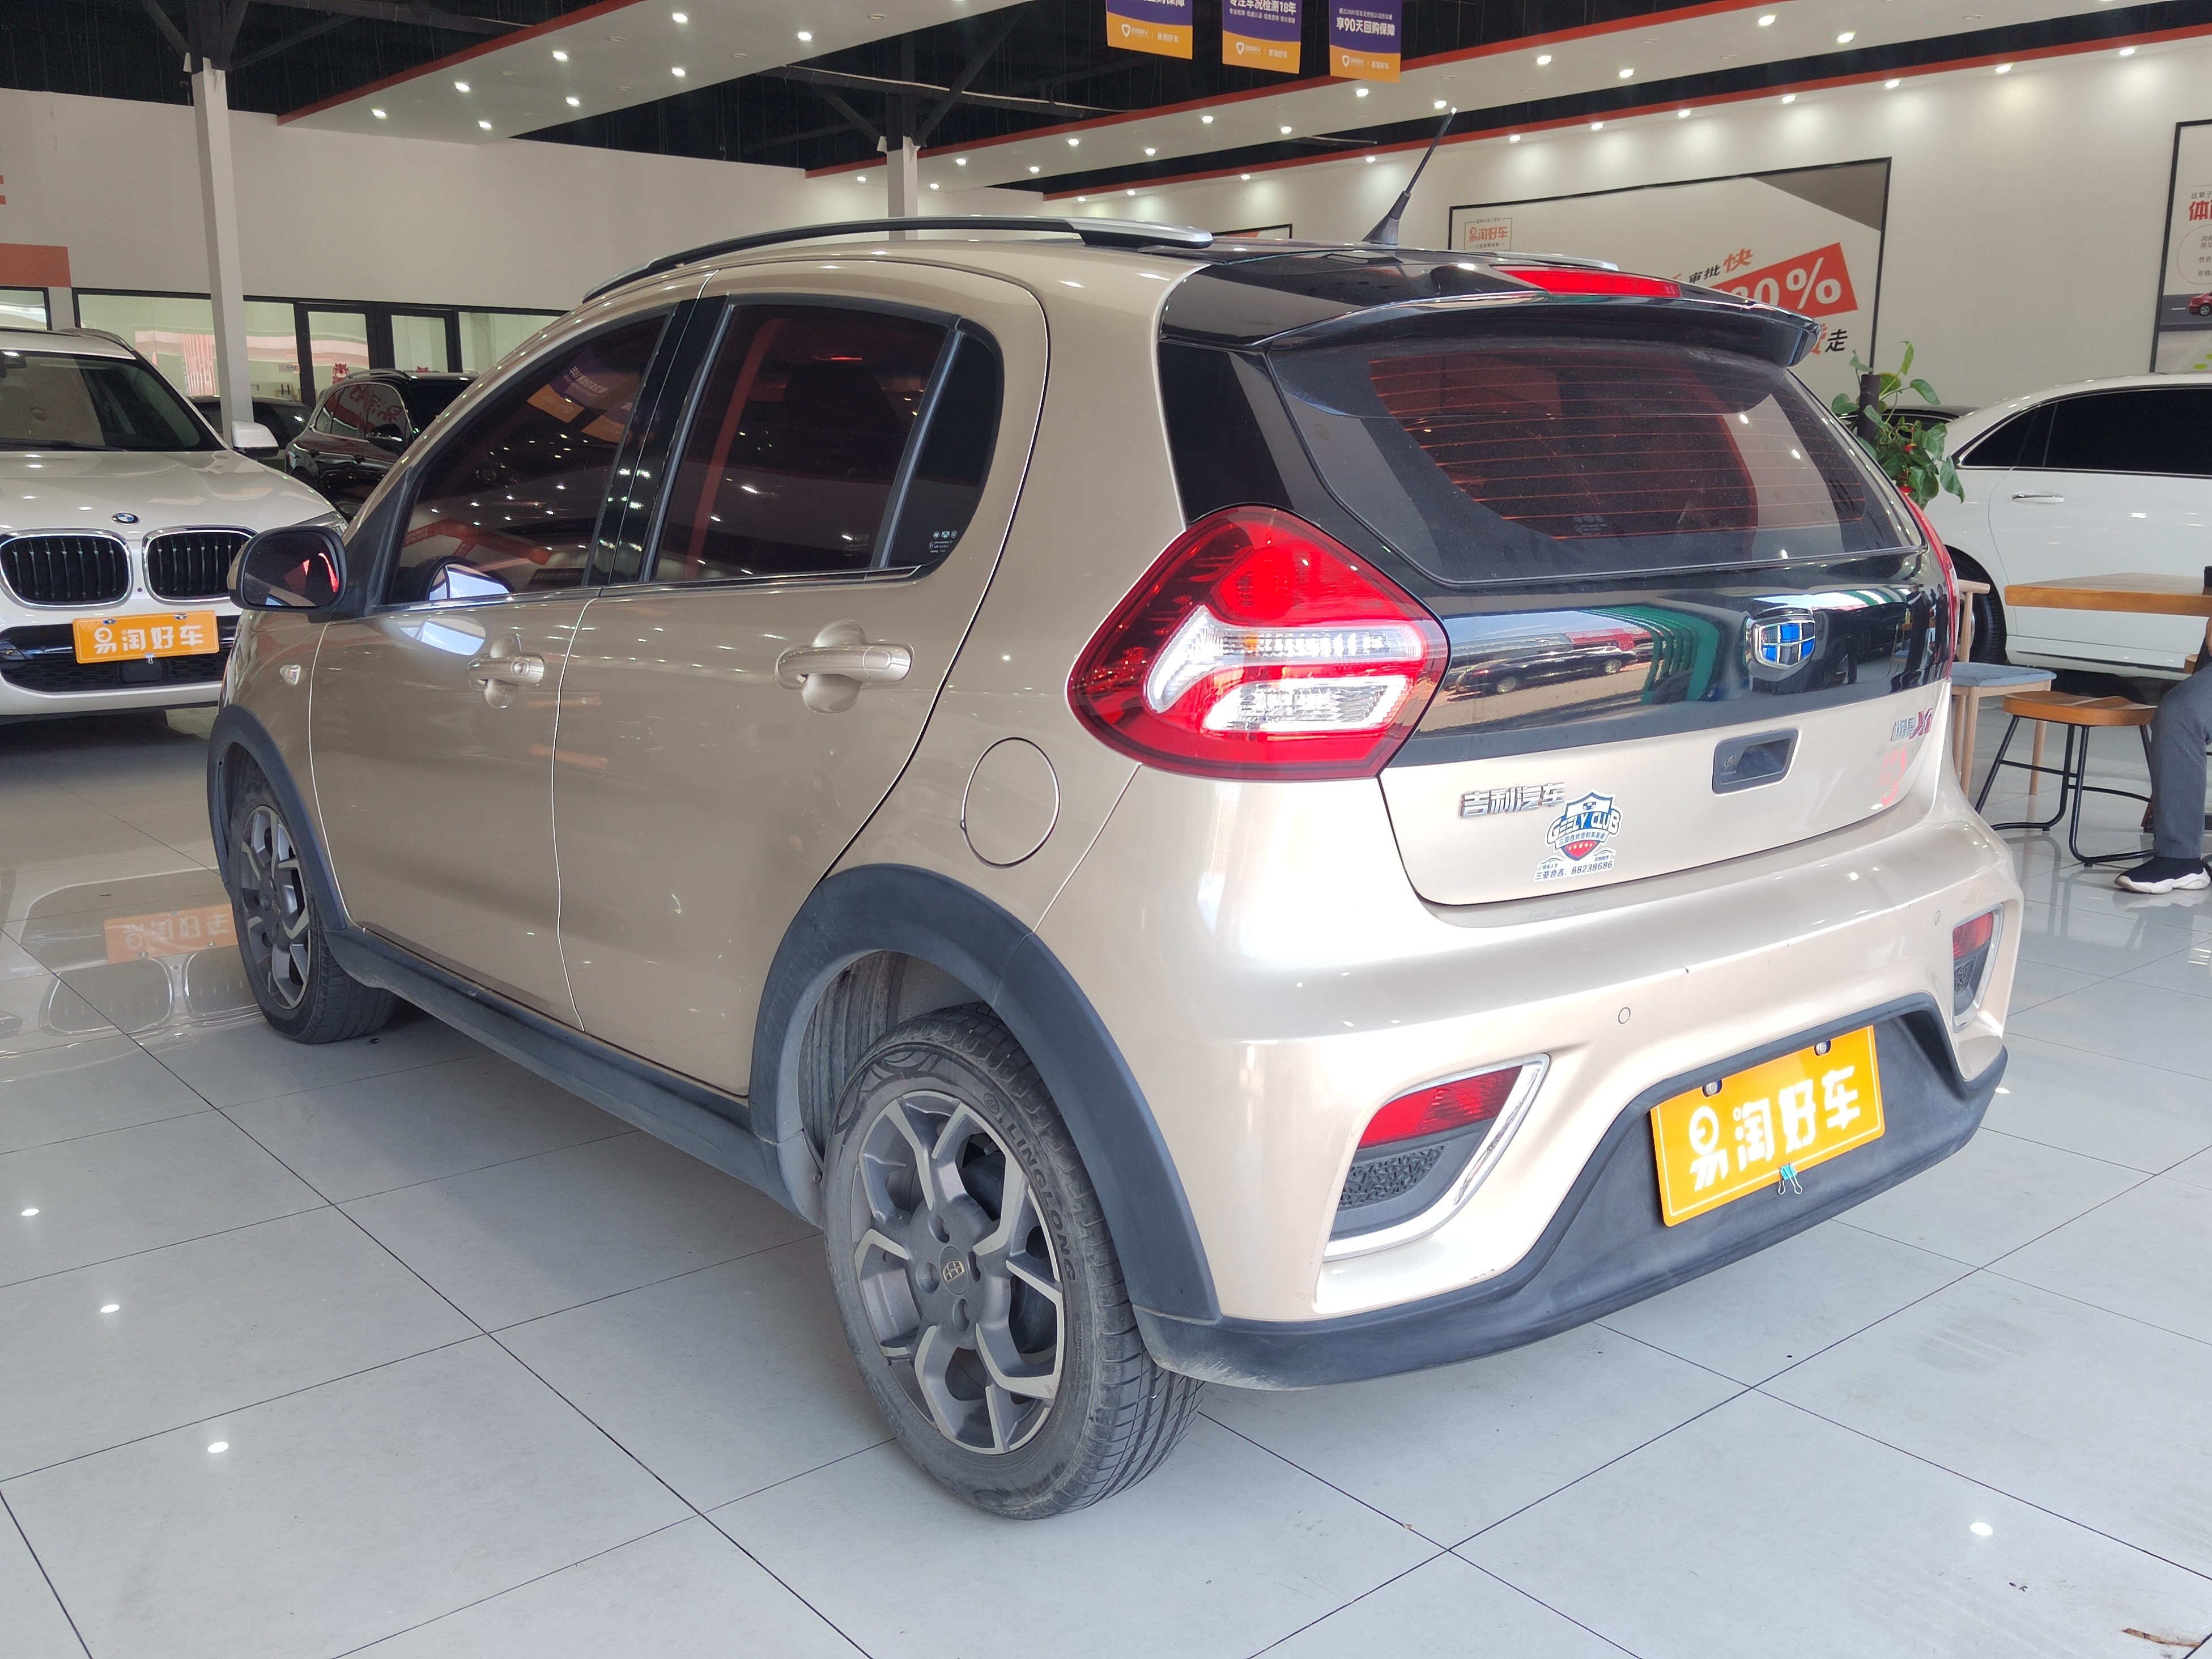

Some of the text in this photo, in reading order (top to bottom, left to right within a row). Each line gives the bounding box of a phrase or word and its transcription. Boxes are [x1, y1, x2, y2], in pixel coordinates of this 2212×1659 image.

[1336, 17, 1396, 36] 享90天回购保障
[2189, 200, 2212, 221] 体
[1469, 227, 1508, 243] 易淘好车
[94, 625, 204, 654] 易淘好车
[1461, 782, 1566, 818] 吉利汽车
[1547, 808, 1621, 844] GEELY CLUB
[1571, 861, 1613, 874] 88238686
[1688, 1066, 1861, 1192] 易淘好车
[1006, 1123, 1076, 1281] LINGLONG
